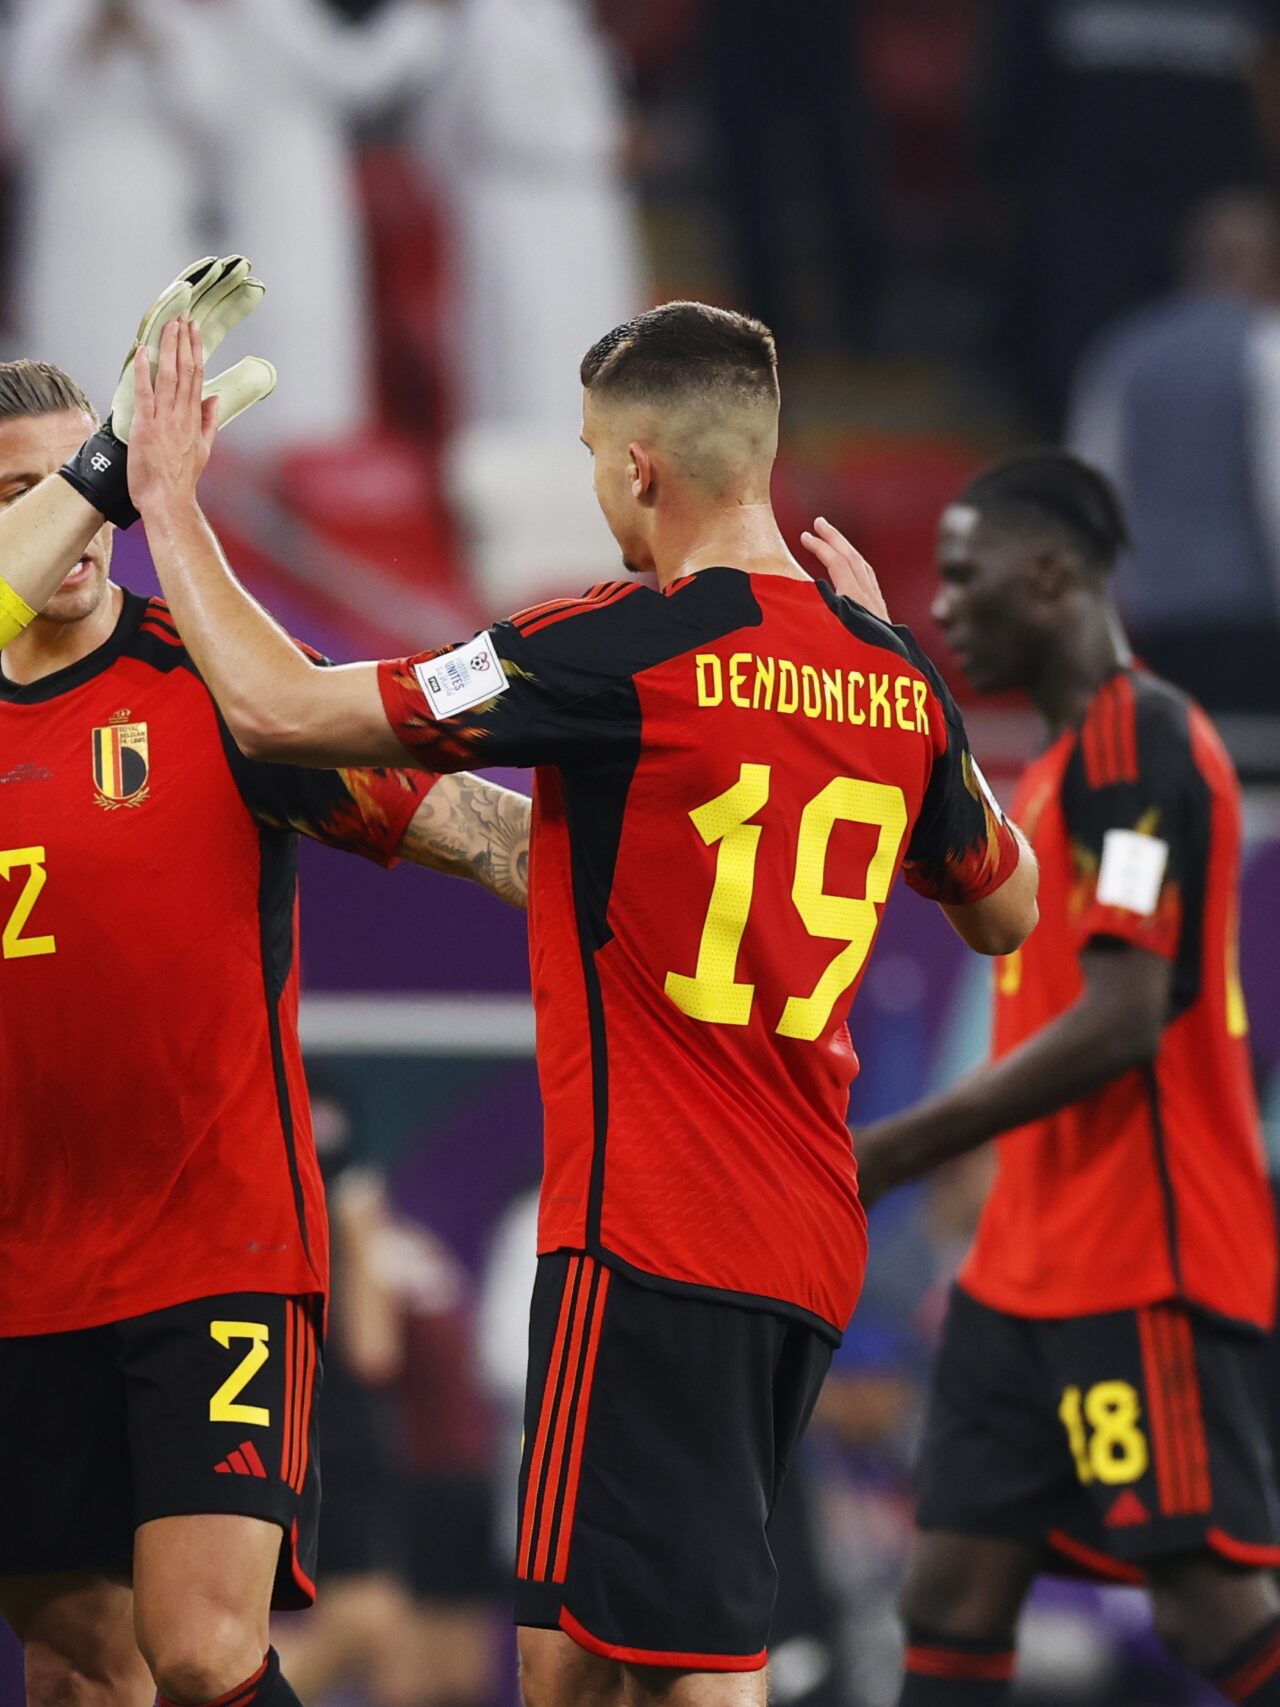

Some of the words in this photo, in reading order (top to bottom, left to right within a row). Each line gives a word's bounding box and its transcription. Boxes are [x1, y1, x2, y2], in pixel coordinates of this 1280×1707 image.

[444, 659, 465, 691] UNITES
[695, 652, 929, 735] DENDONCKER
[664, 762, 908, 1042] 19
[209, 1320, 270, 1428] 2
[1058, 1380, 1149, 1487] 18
